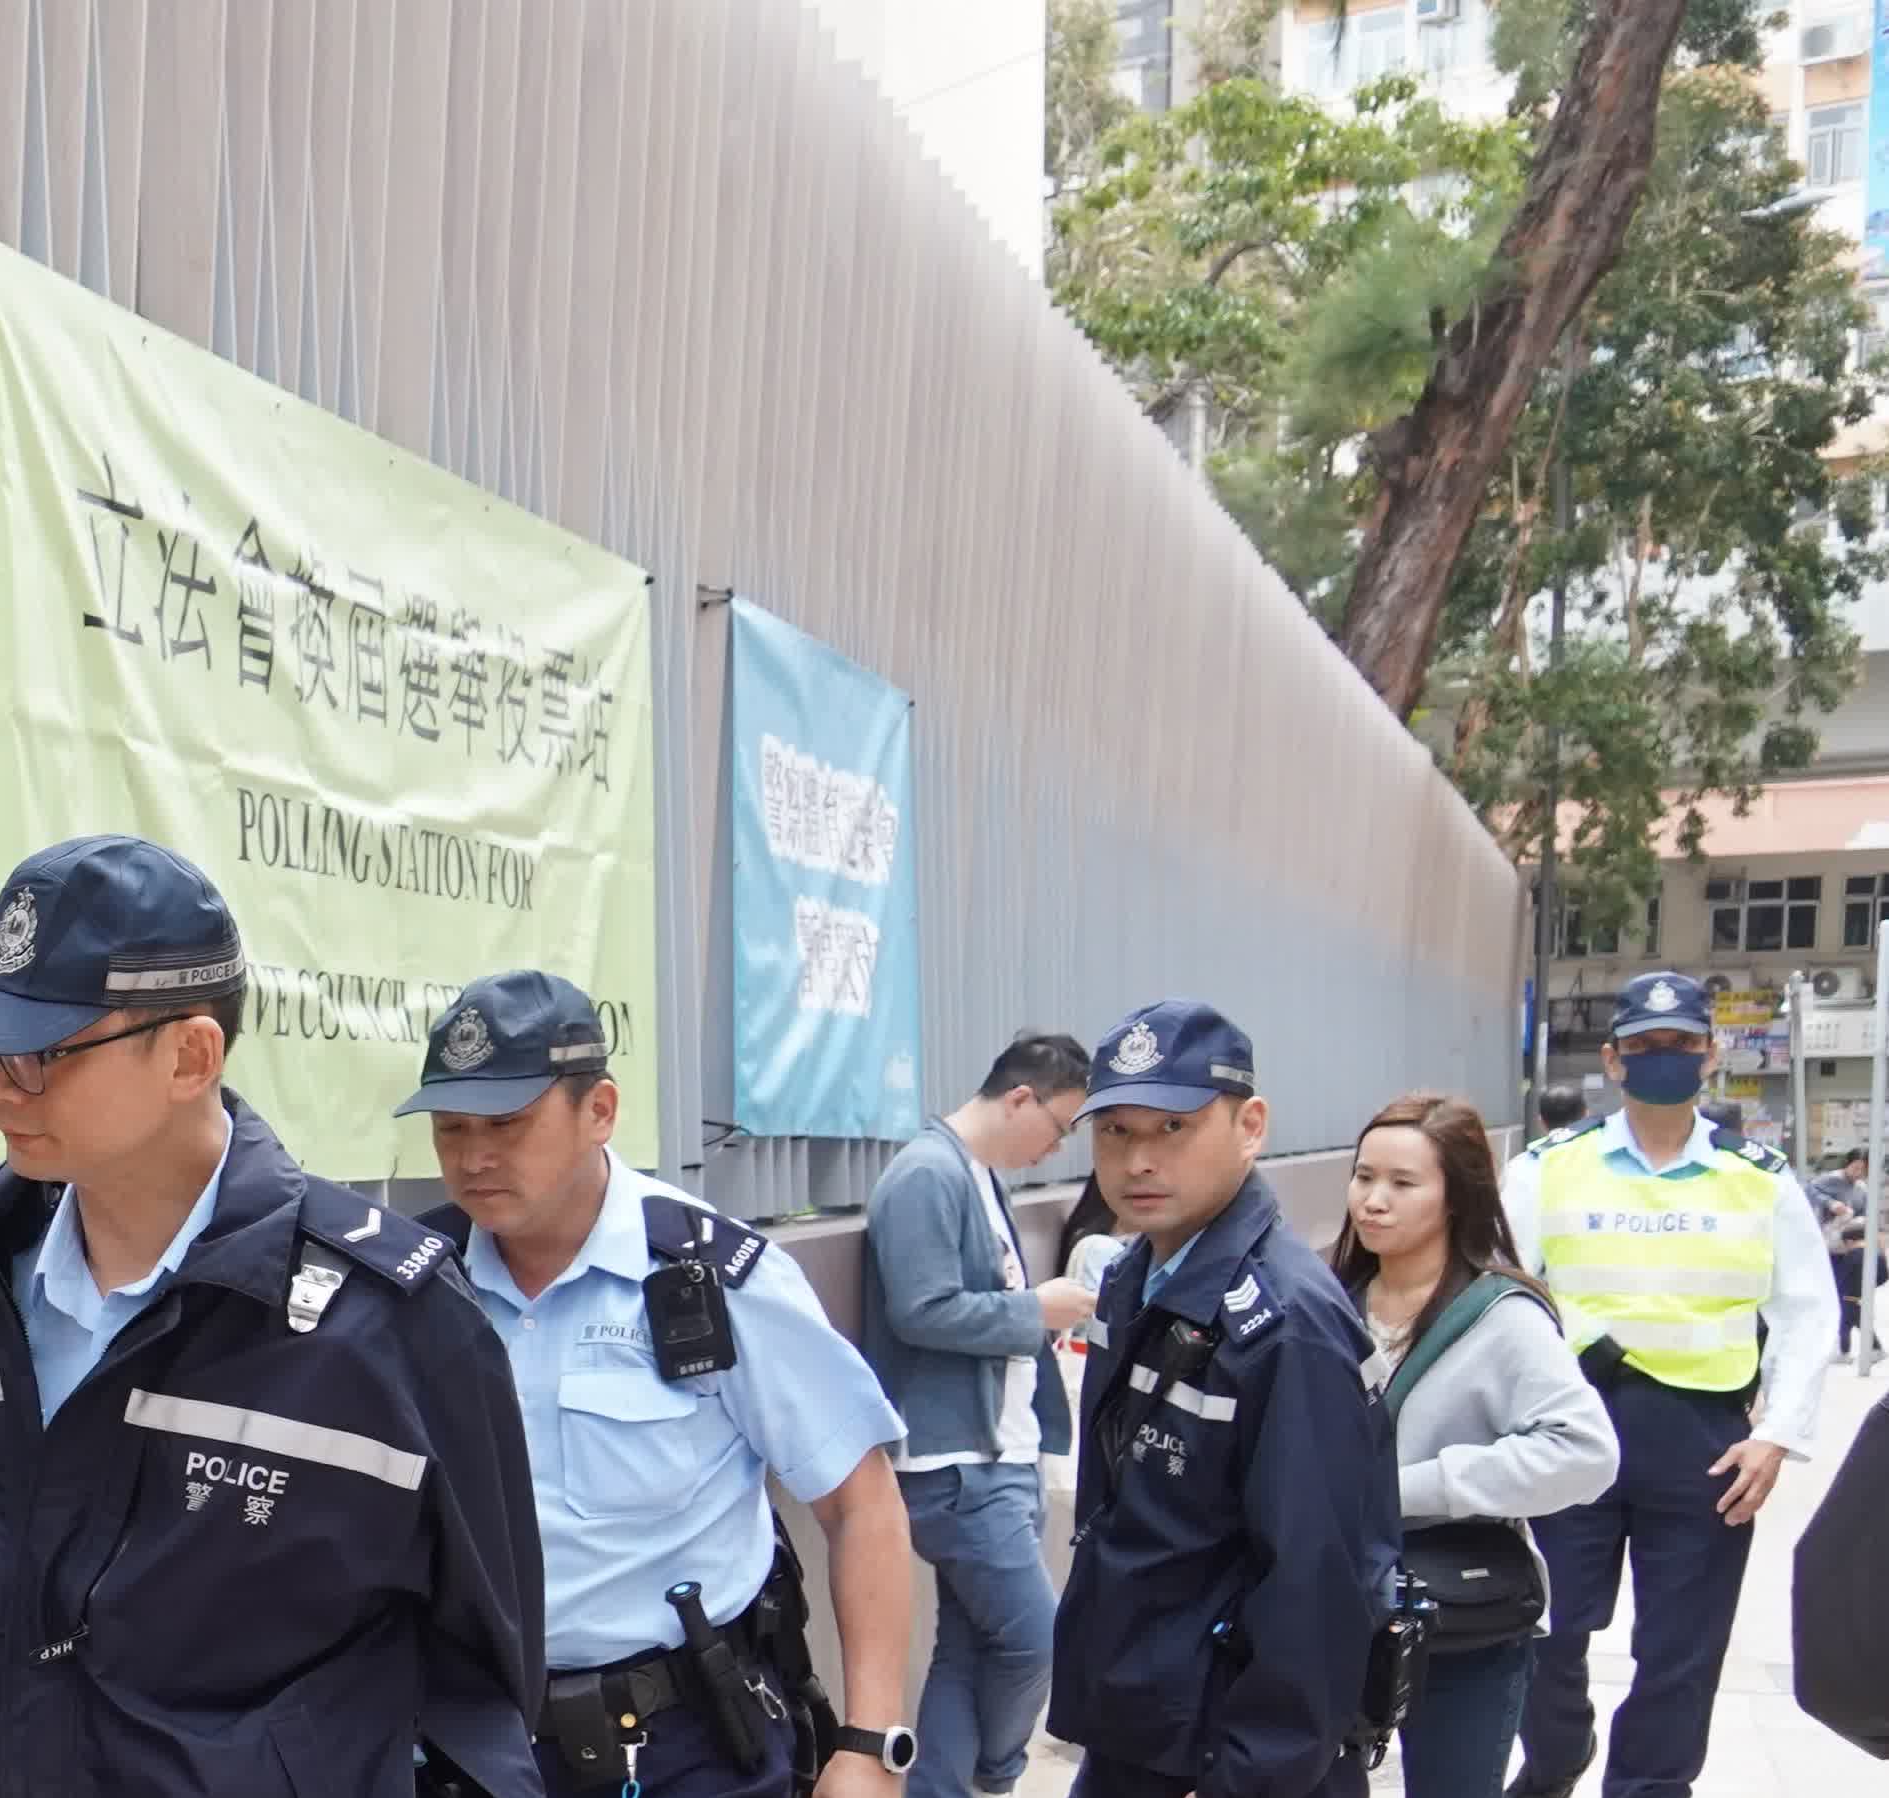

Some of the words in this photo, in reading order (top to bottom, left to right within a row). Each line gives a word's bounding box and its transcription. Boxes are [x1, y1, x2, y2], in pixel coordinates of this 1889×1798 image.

[238, 787, 373, 886] POLLING
[375, 806, 478, 904] STATION
[486, 843, 534, 912] FOR
[191, 963, 231, 984] POLICE
[1614, 1213, 1690, 1233] POLICE
[397, 1237, 443, 1280] 33840
[725, 1236, 760, 1277] A6018
[1240, 1308, 1272, 1335] 2224
[599, 1325, 649, 1346] POLIC
[185, 1452, 290, 1494] POLICE
[40, 1640, 73, 1660] HKP
